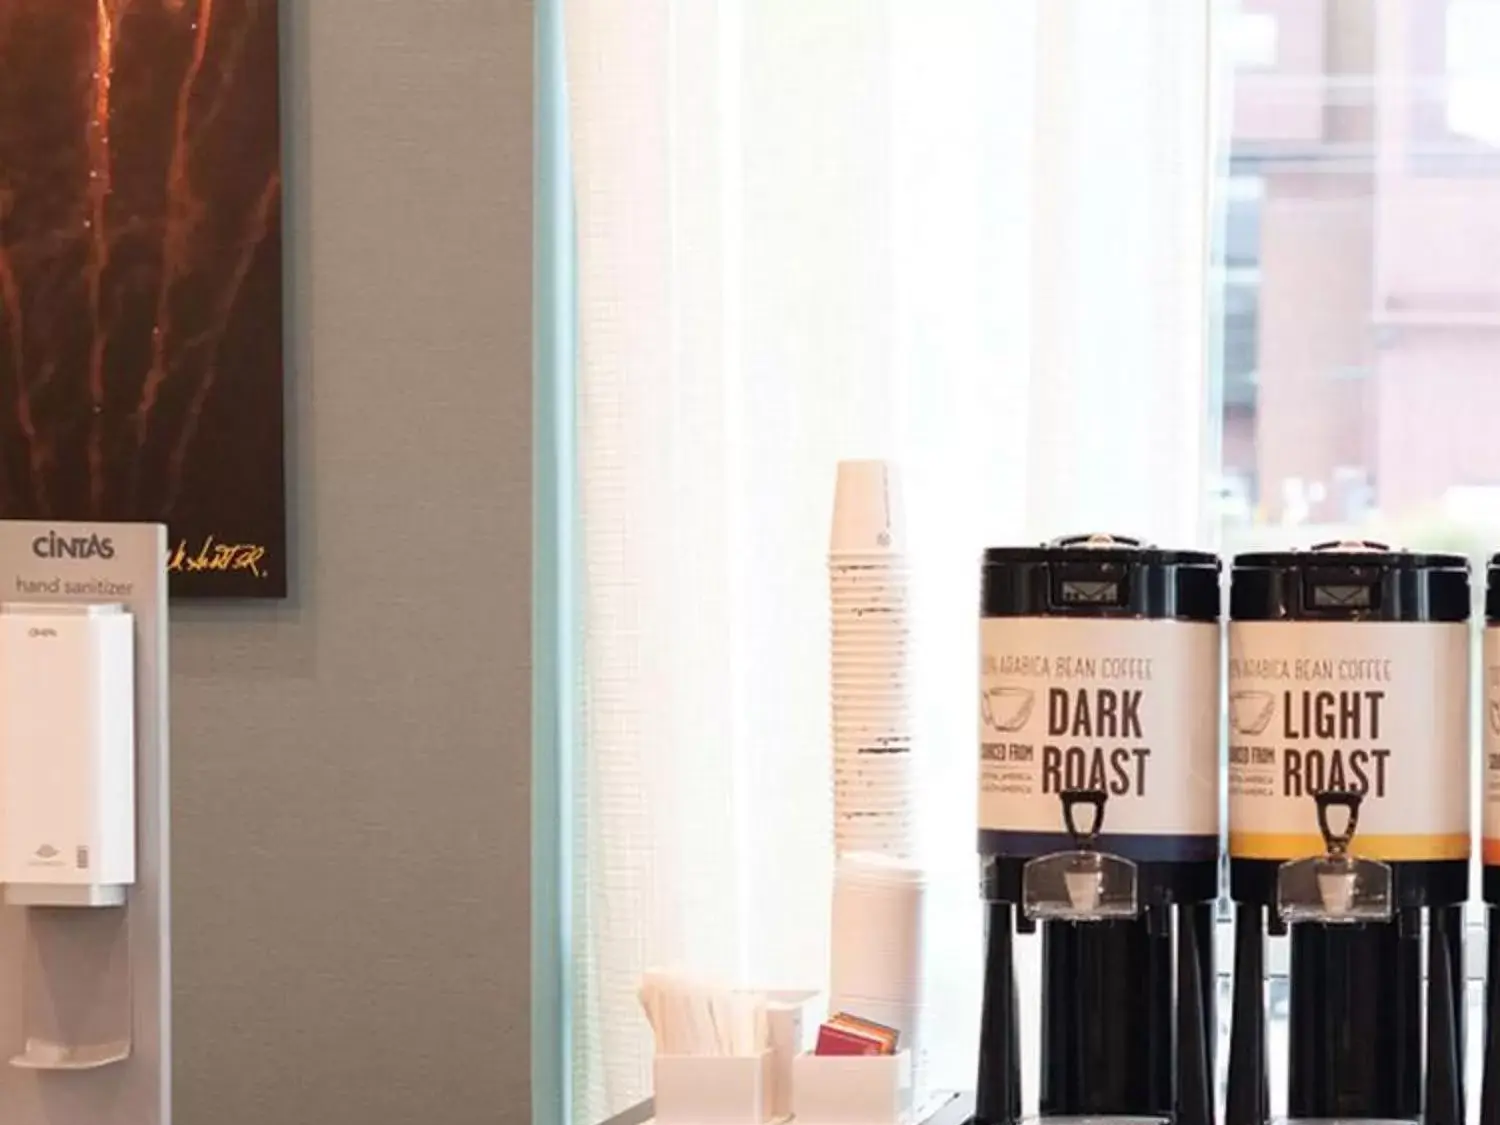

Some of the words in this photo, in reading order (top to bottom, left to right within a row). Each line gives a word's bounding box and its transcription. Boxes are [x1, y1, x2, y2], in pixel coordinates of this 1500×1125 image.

[16, 576, 60, 595] hand
[65, 577, 134, 596] sanitizer
[1056, 656, 1096, 680] BEAN
[1102, 657, 1153, 681] COFFEE
[1294, 659, 1333, 681] BEAN
[1338, 659, 1392, 682] COFFEE
[1048, 687, 1143, 738] DARK
[1284, 690, 1384, 739] LIGHT
[1042, 746, 1150, 796] ROAST
[1284, 749, 1390, 798] ROAST
